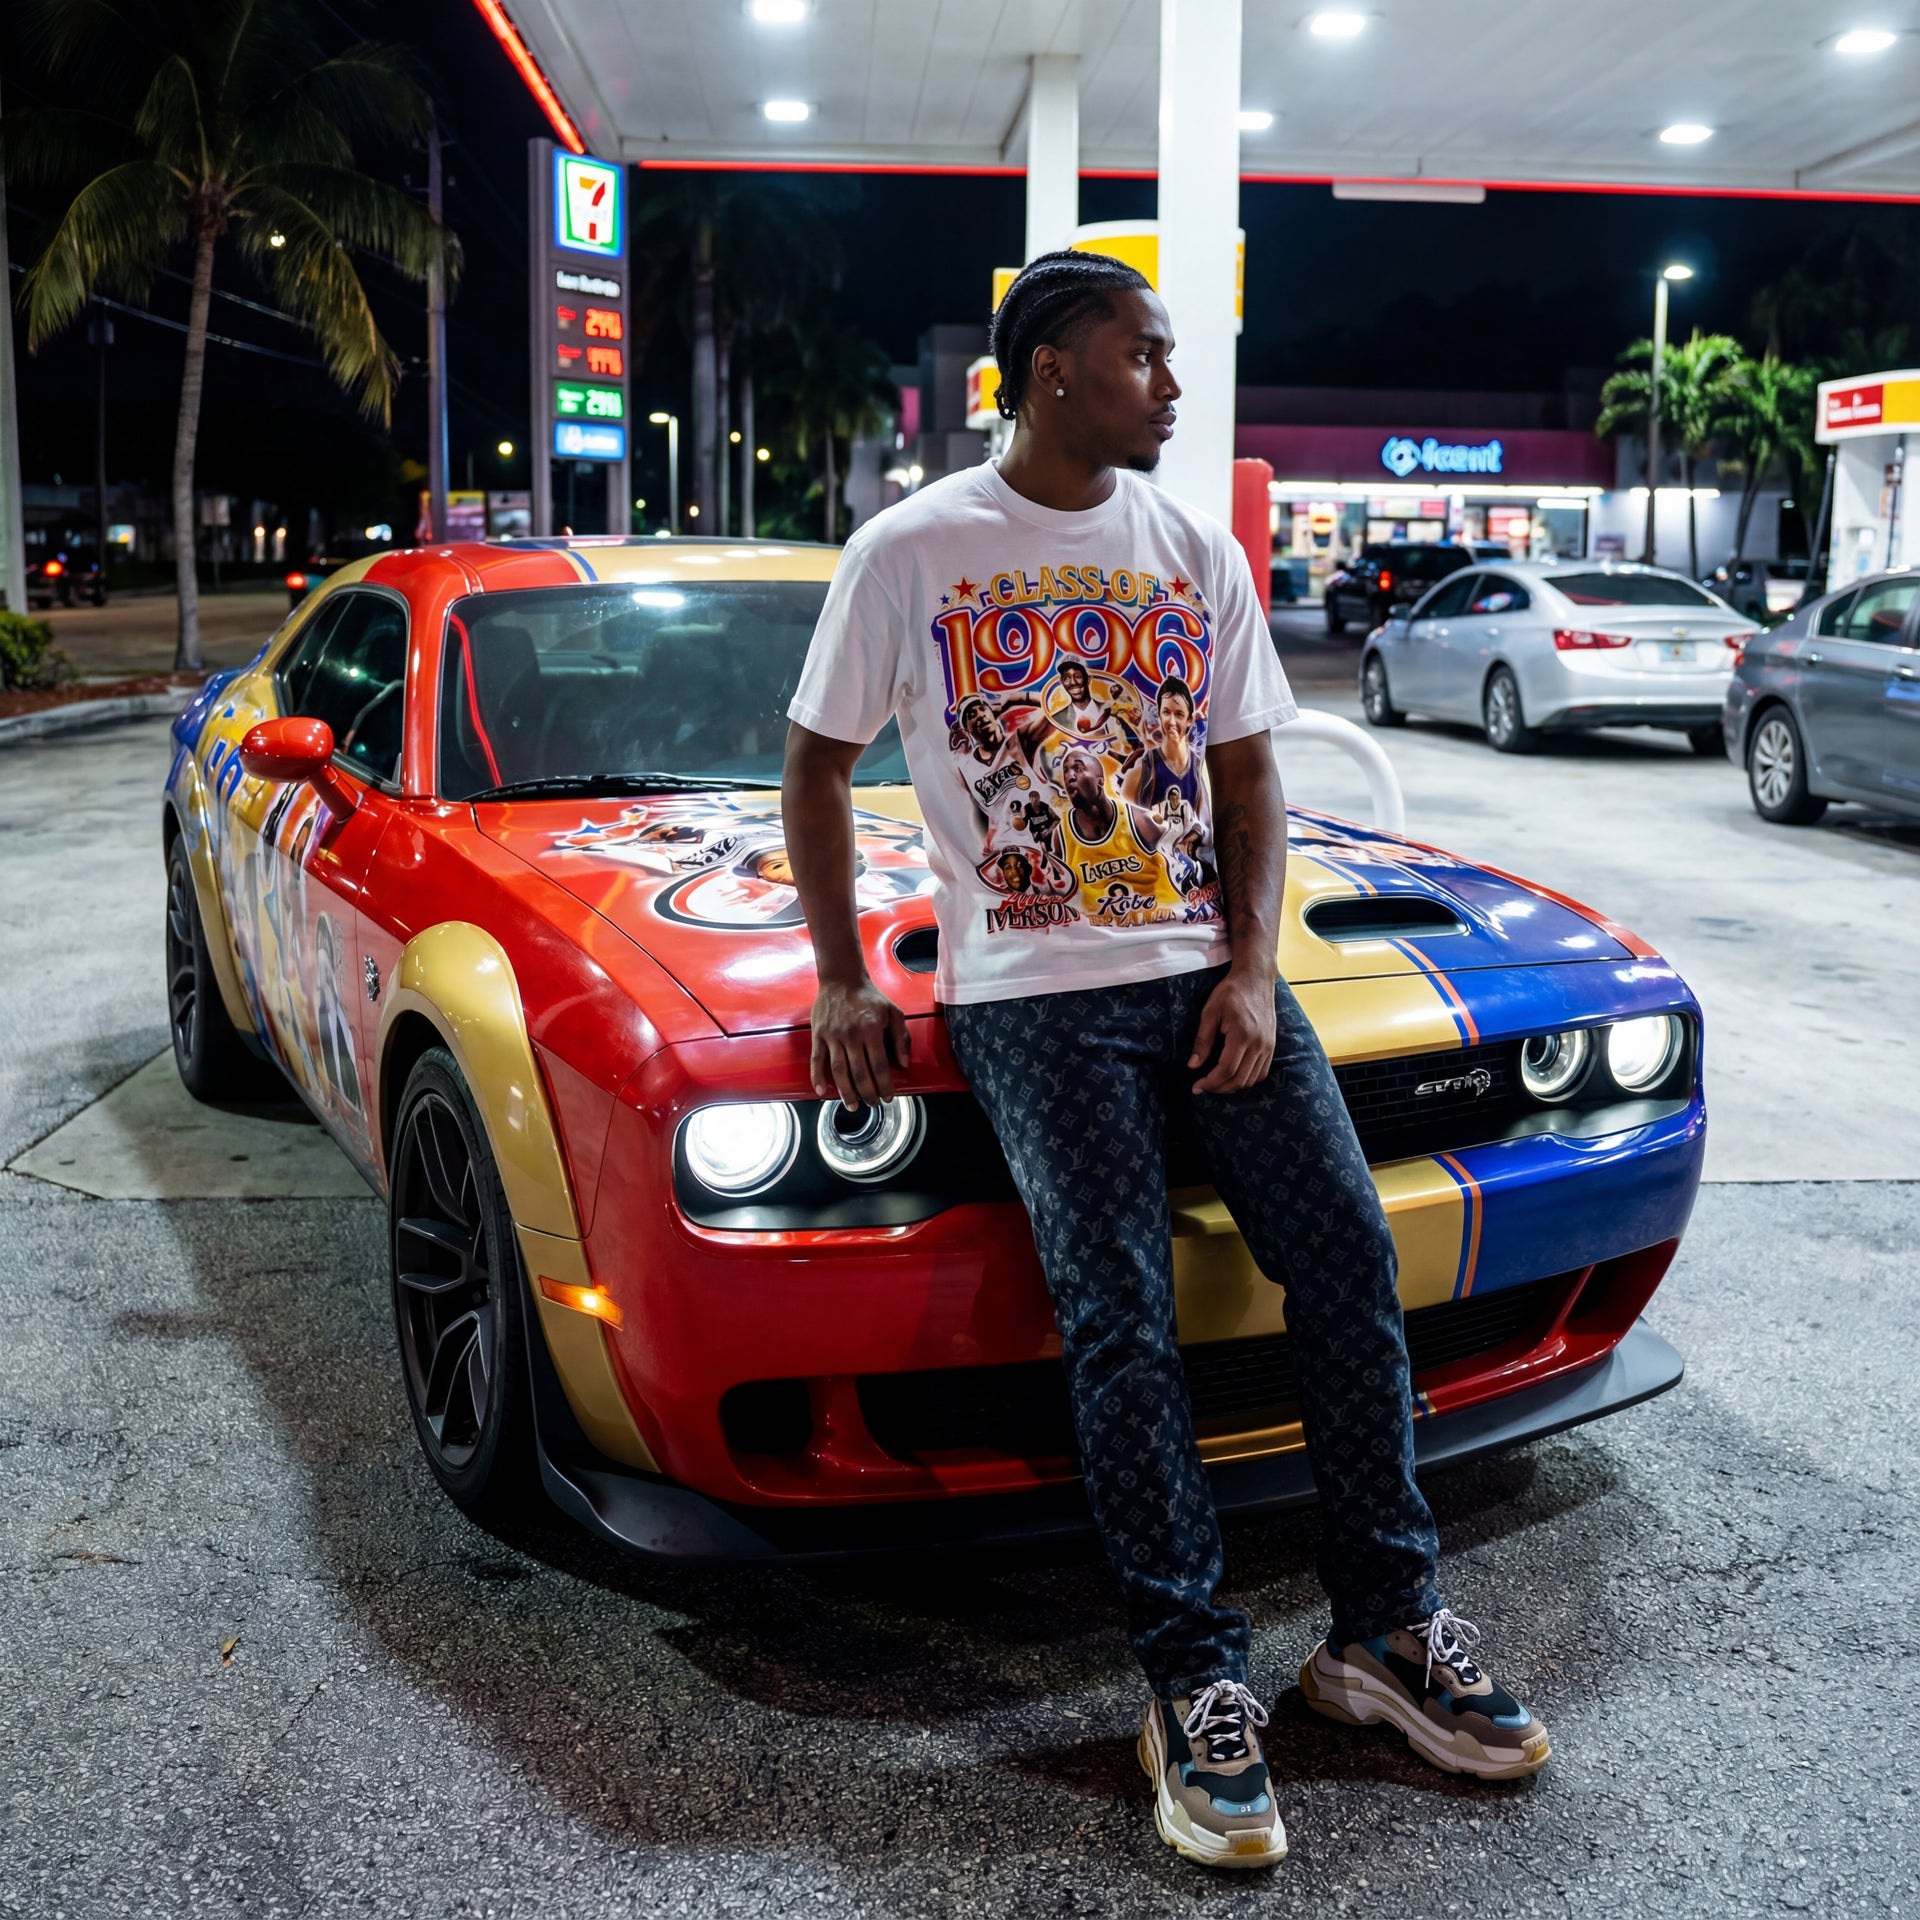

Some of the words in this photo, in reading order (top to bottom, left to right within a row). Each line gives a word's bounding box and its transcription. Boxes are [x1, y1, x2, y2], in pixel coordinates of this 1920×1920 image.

[990, 564, 1103, 607] CLASS
[1109, 568, 1159, 607] OF
[932, 602, 1211, 718] 1996
[1079, 855, 1144, 884] LAKERS
